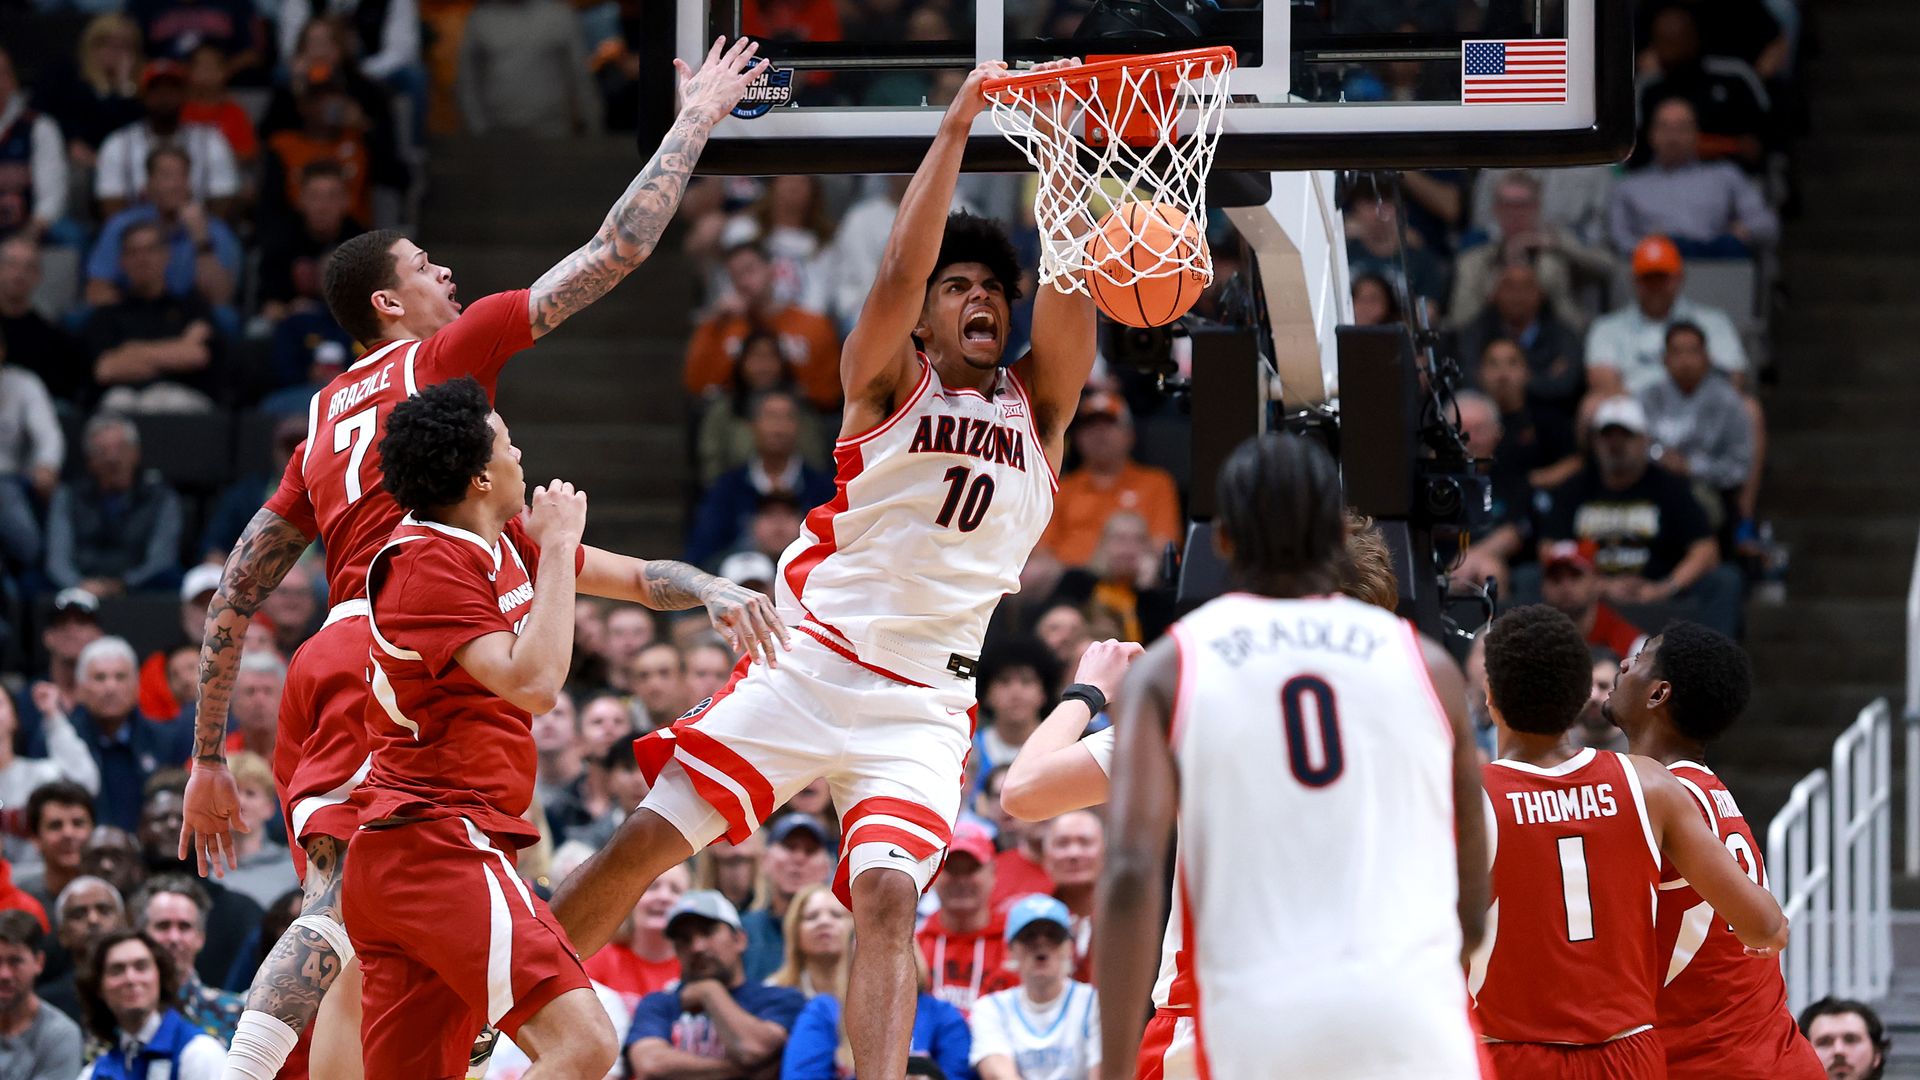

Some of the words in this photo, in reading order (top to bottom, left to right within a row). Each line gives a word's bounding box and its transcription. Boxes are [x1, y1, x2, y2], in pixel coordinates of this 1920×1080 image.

[740, 87, 789, 100] ADNESS
[327, 362, 395, 422] BRAZILE
[333, 404, 378, 505] 7
[908, 415, 1026, 473] ARIZONA
[935, 465, 995, 533] 10
[498, 580, 535, 614] RKANS
[1208, 617, 1387, 669] BRADLEY
[1280, 673, 1346, 788] 0
[1506, 783, 1619, 825] THOMAS
[1557, 836, 1595, 942] 1
[301, 951, 341, 991] 42
